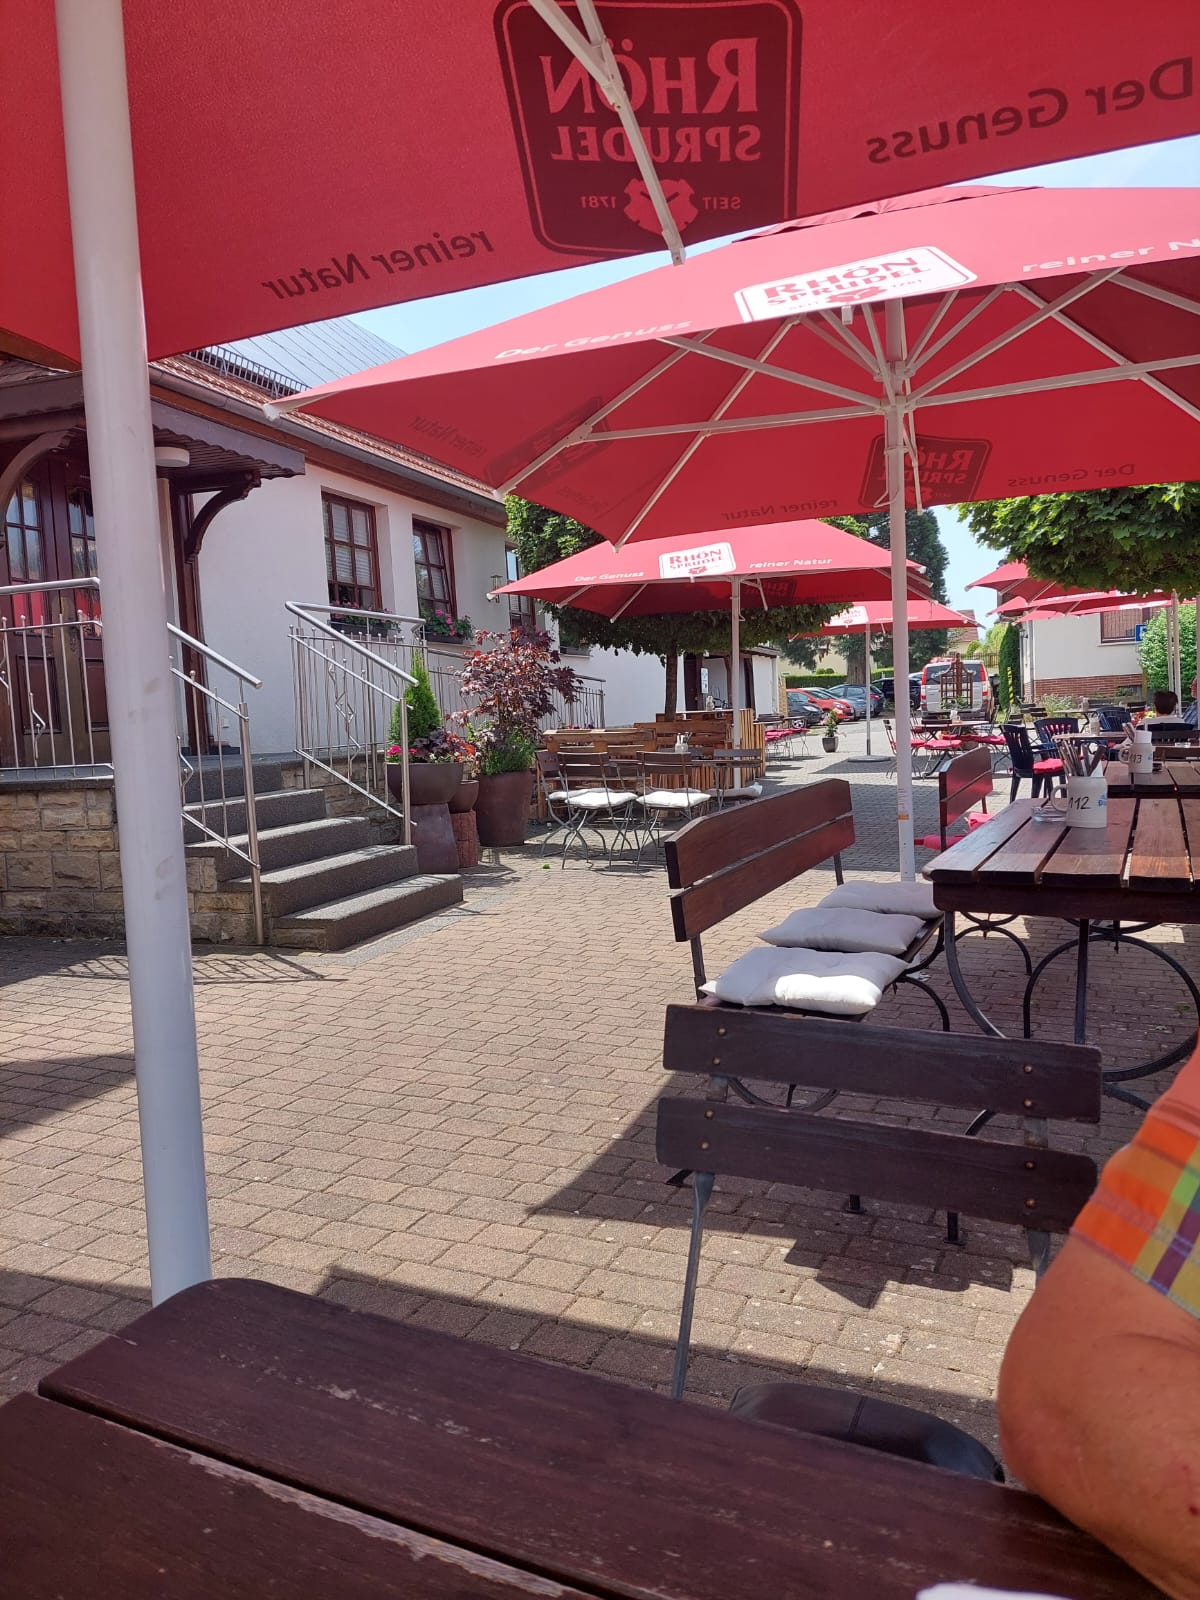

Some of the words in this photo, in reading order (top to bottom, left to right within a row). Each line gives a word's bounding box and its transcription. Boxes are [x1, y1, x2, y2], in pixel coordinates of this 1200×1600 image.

[1022, 246, 1155, 272] reiner
[764, 257, 919, 298] RHÖN
[767, 266, 932, 305] SPRUDEL
[494, 342, 559, 360] Der
[564, 320, 694, 348] Genuss
[749, 560, 792, 569] reiner
[793, 557, 833, 566] Natur
[574, 573, 598, 583] Der
[1068, 796, 1092, 810] 112
